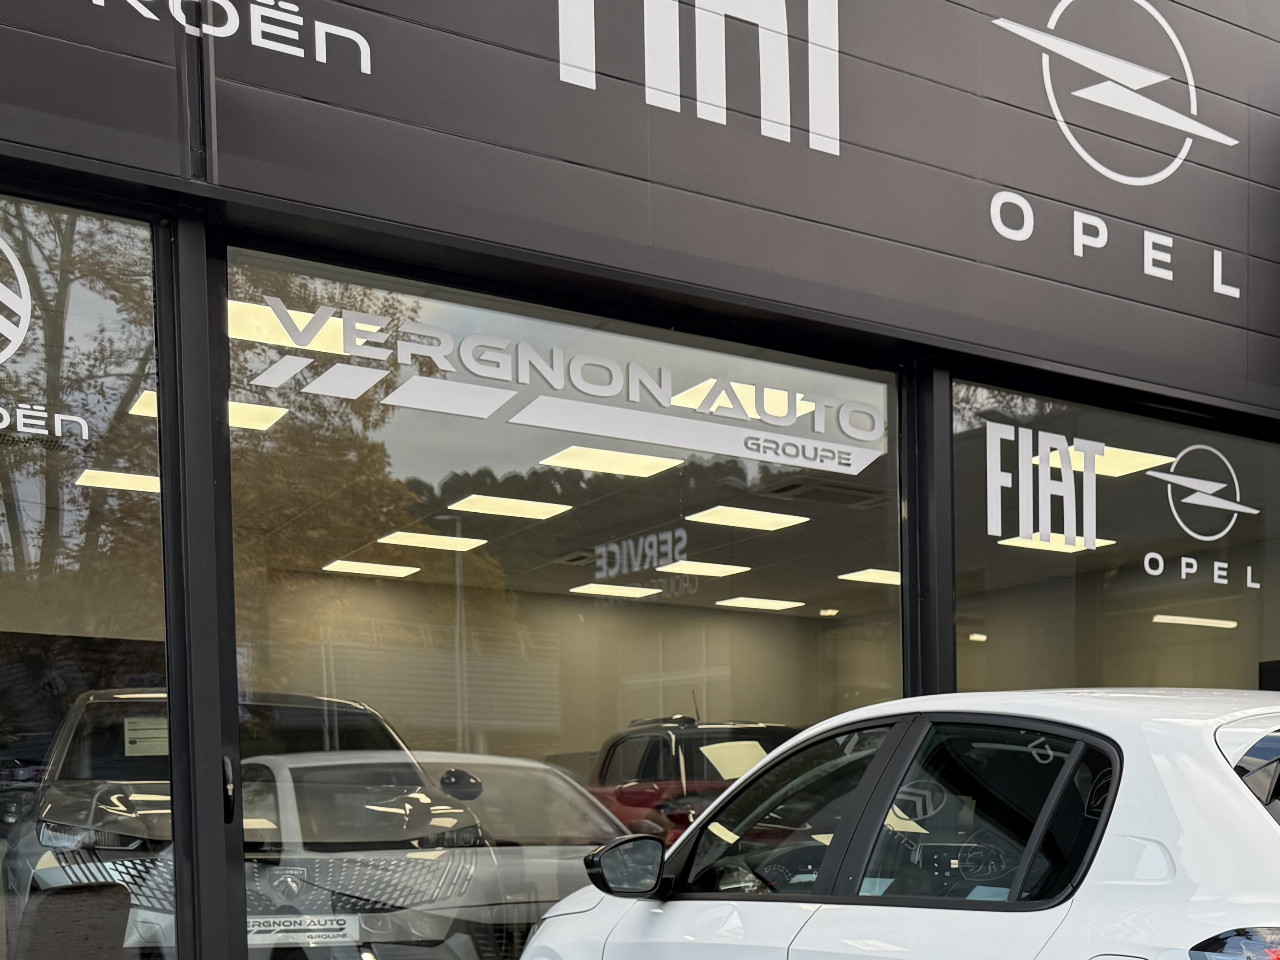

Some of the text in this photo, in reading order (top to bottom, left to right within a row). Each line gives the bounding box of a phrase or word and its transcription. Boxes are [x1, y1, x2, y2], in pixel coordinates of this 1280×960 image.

[990, 190, 1240, 299] OPEL
[262, 295, 887, 442] VERGNON AUTO
[743, 436, 852, 467] GROUPE
[986, 421, 1106, 550] FIAT
[1143, 552, 1261, 589] OPEL
[306, 918, 347, 928] AUTO
